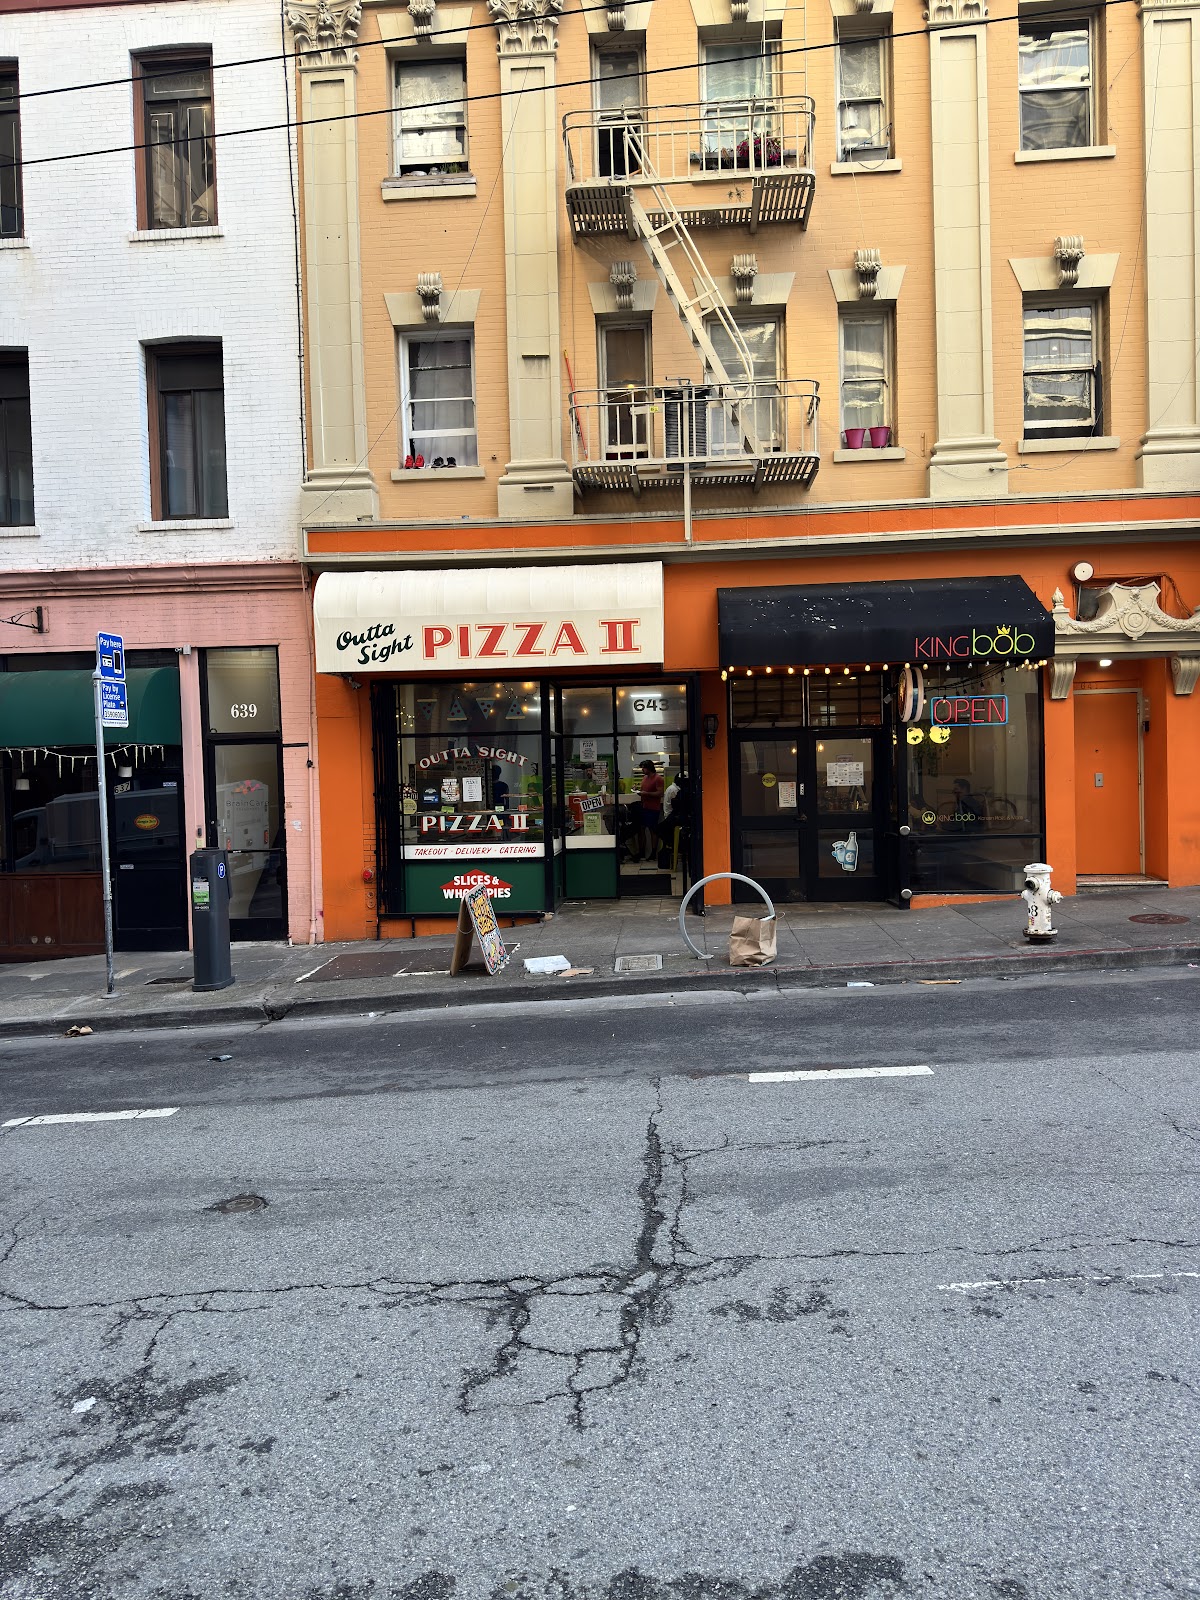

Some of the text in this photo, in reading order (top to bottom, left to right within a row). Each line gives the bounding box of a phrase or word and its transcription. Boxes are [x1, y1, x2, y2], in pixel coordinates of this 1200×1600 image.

[100, 637, 122, 649] Pay here
[336, 623, 396, 651] Outta
[422, 618, 642, 660] PIZZA II
[357, 634, 414, 665] Sight
[102, 683, 119, 694] Pay by
[102, 691, 121, 701] License
[103, 700, 116, 709] Plate
[230, 703, 258, 719] 639
[633, 699, 670, 712] 643
[933, 698, 1006, 724] OPEN
[419, 746, 528, 770] OUTTA SIGHT
[114, 781, 130, 794] 637
[582, 798, 603, 811] OPEN
[421, 813, 530, 834] PIZZA II
[414, 846, 537, 856] TAKEOUT DELIVERY CATERING
[453, 875, 491, 886] SLICES
[486, 888, 511, 899] PIES
